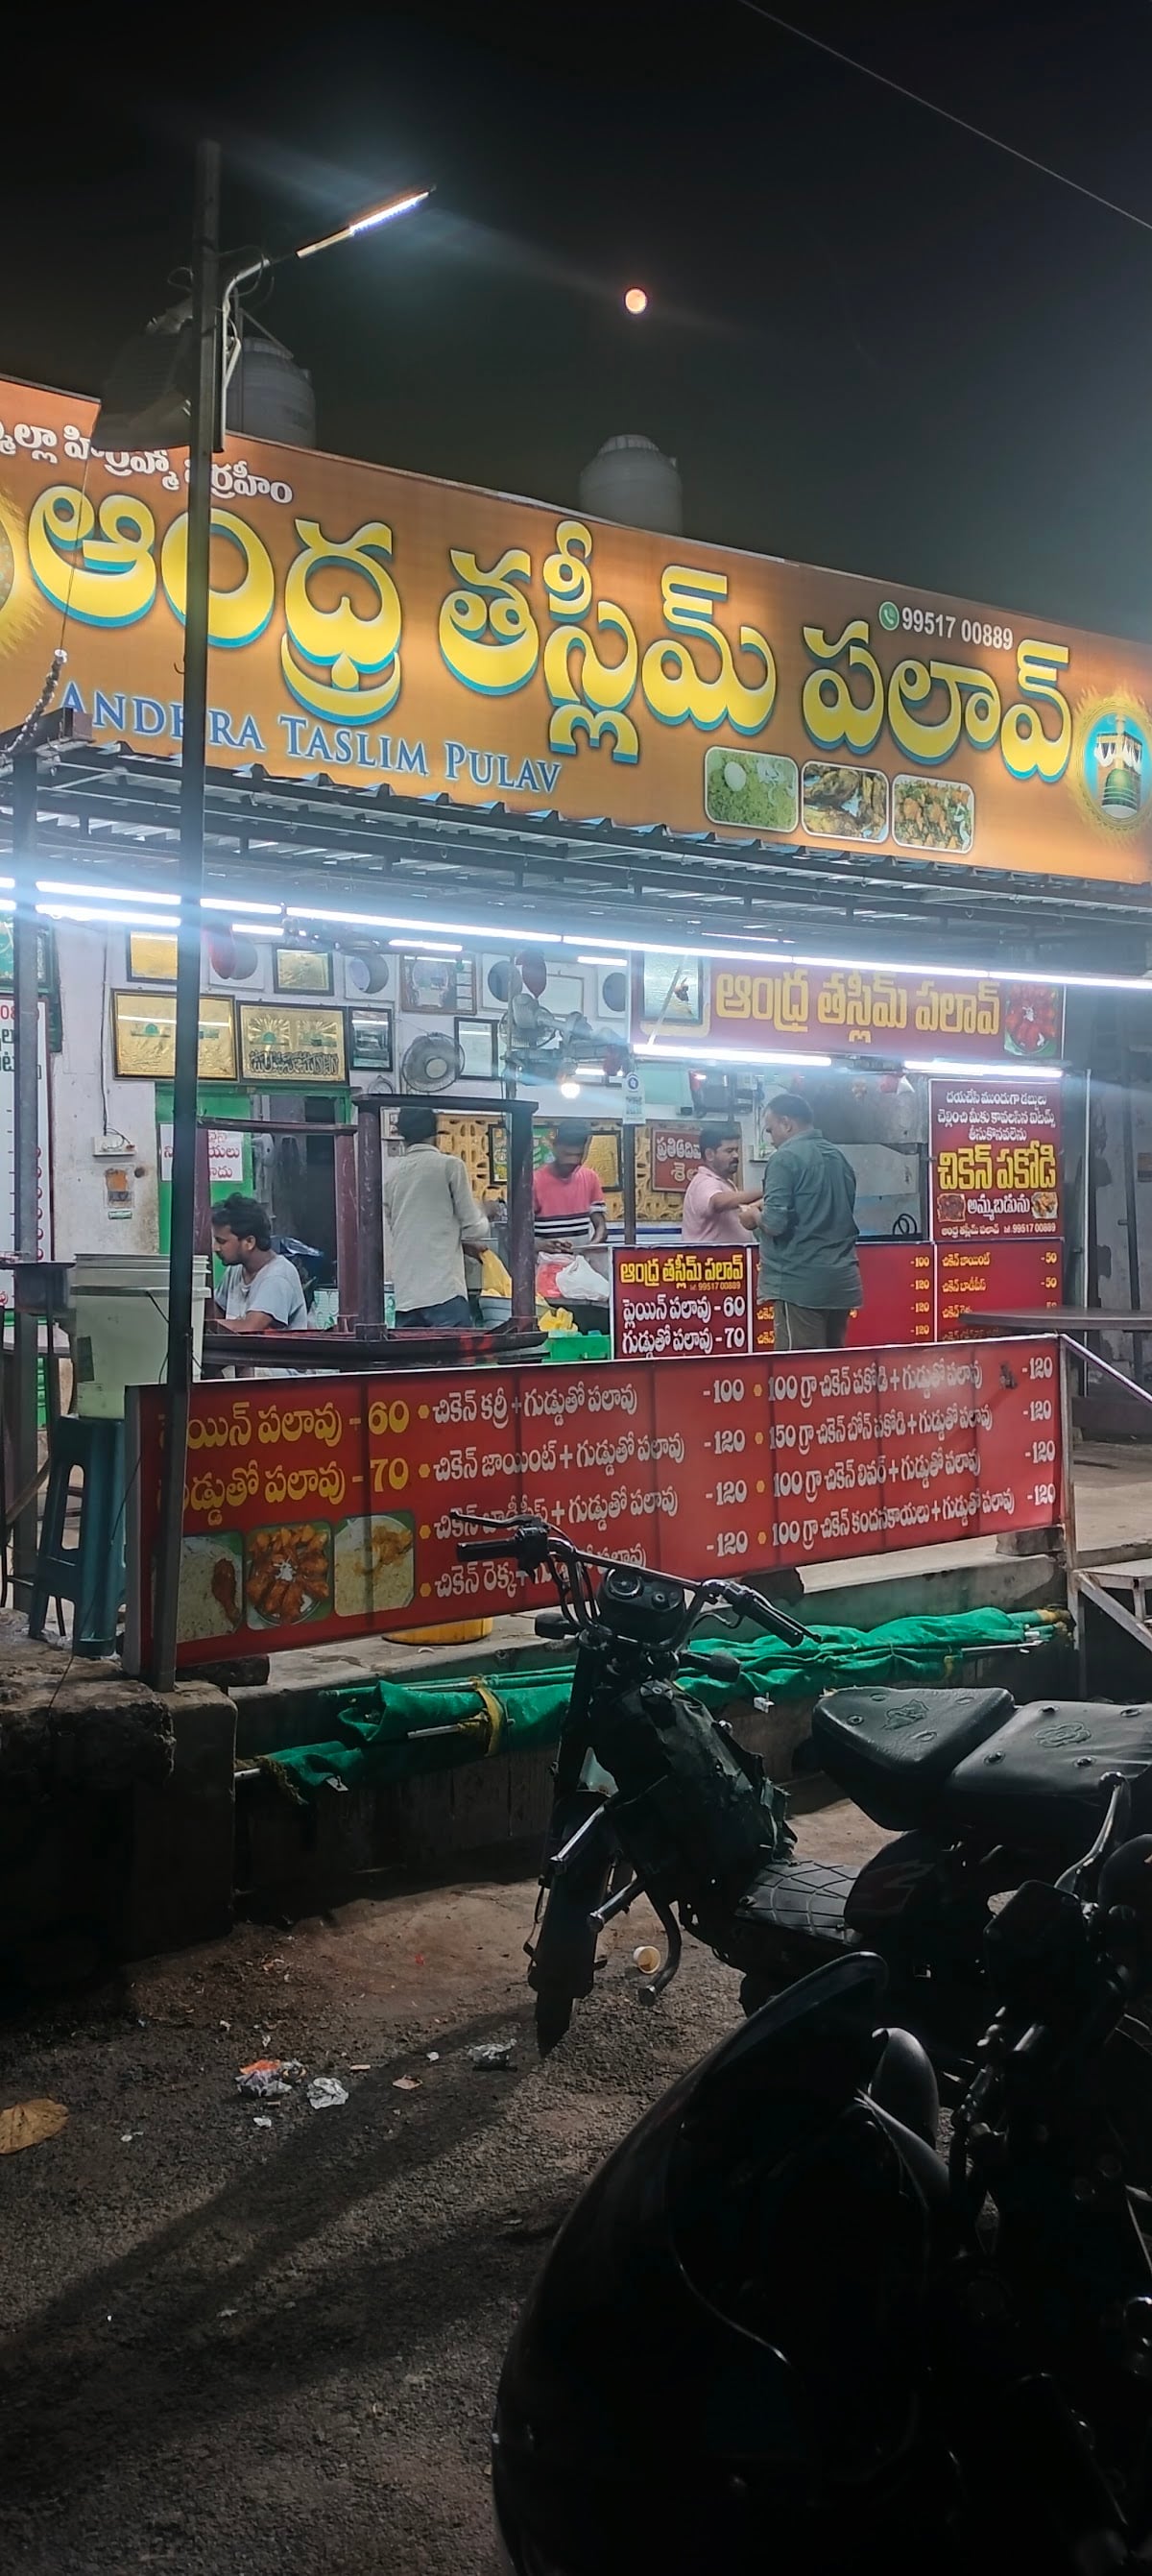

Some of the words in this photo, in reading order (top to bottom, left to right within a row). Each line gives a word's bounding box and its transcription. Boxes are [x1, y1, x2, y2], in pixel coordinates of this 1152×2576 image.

[27, 484, 402, 727] ఆంధ్ర
[439, 518, 777, 764] తస్లీమ్
[802, 619, 1072, 783] పలావ్
[900, 607, 957, 638] 99517
[960, 619, 1015, 651] 00889
[278, 714, 429, 777] TASLIM
[444, 740, 563, 794] PULAV
[715, 968, 809, 1033] ఆంధ్ర
[817, 969, 907, 1044] తస్లీమ్
[915, 980, 1001, 1036] పలావ్
[937, 1144, 993, 1191] చికెన్
[996, 1140, 1057, 1190] పకోడి
[620, 1258, 660, 1287] ఆంధ్ర
[705, 1254, 743, 1281] పలావ్
[669, 1295, 711, 1323] పలావు
[723, 1295, 745, 1317] 60
[673, 1327, 712, 1354] పలావు
[724, 1327, 745, 1349] 70
[432, 1389, 478, 1424] చికెన్
[524, 1381, 584, 1426] గుడ్డుతో
[588, 1383, 637, 1415] పలావు
[768, 1375, 798, 1402] 100
[819, 1366, 852, 1397] చికెన్
[947, 1360, 982, 1389] పలావు
[257, 1402, 343, 1447] పలావు
[368, 1400, 410, 1435] 60
[769, 1424, 797, 1450] 150
[816, 1414, 846, 1445] చికెన్
[959, 1404, 993, 1431] పలావు
[432, 1447, 478, 1481] చికెన్
[481, 1439, 557, 1478] జాయింట్
[576, 1431, 635, 1477] గుడ్డుతో
[636, 1432, 685, 1464] పలావు
[774, 1470, 803, 1497] 100
[824, 1458, 854, 1492] చికెన్
[945, 1447, 981, 1477] పలావు
[264, 1460, 346, 1505] పలావు
[370, 1457, 409, 1493] 70
[568, 1484, 628, 1531] గుడ్డుతో
[630, 1485, 679, 1518] పలావు
[772, 1520, 801, 1547] 100
[820, 1507, 850, 1540] చికెన్
[982, 1486, 1016, 1515] పలావు
[434, 1560, 479, 1598] చికెన్
